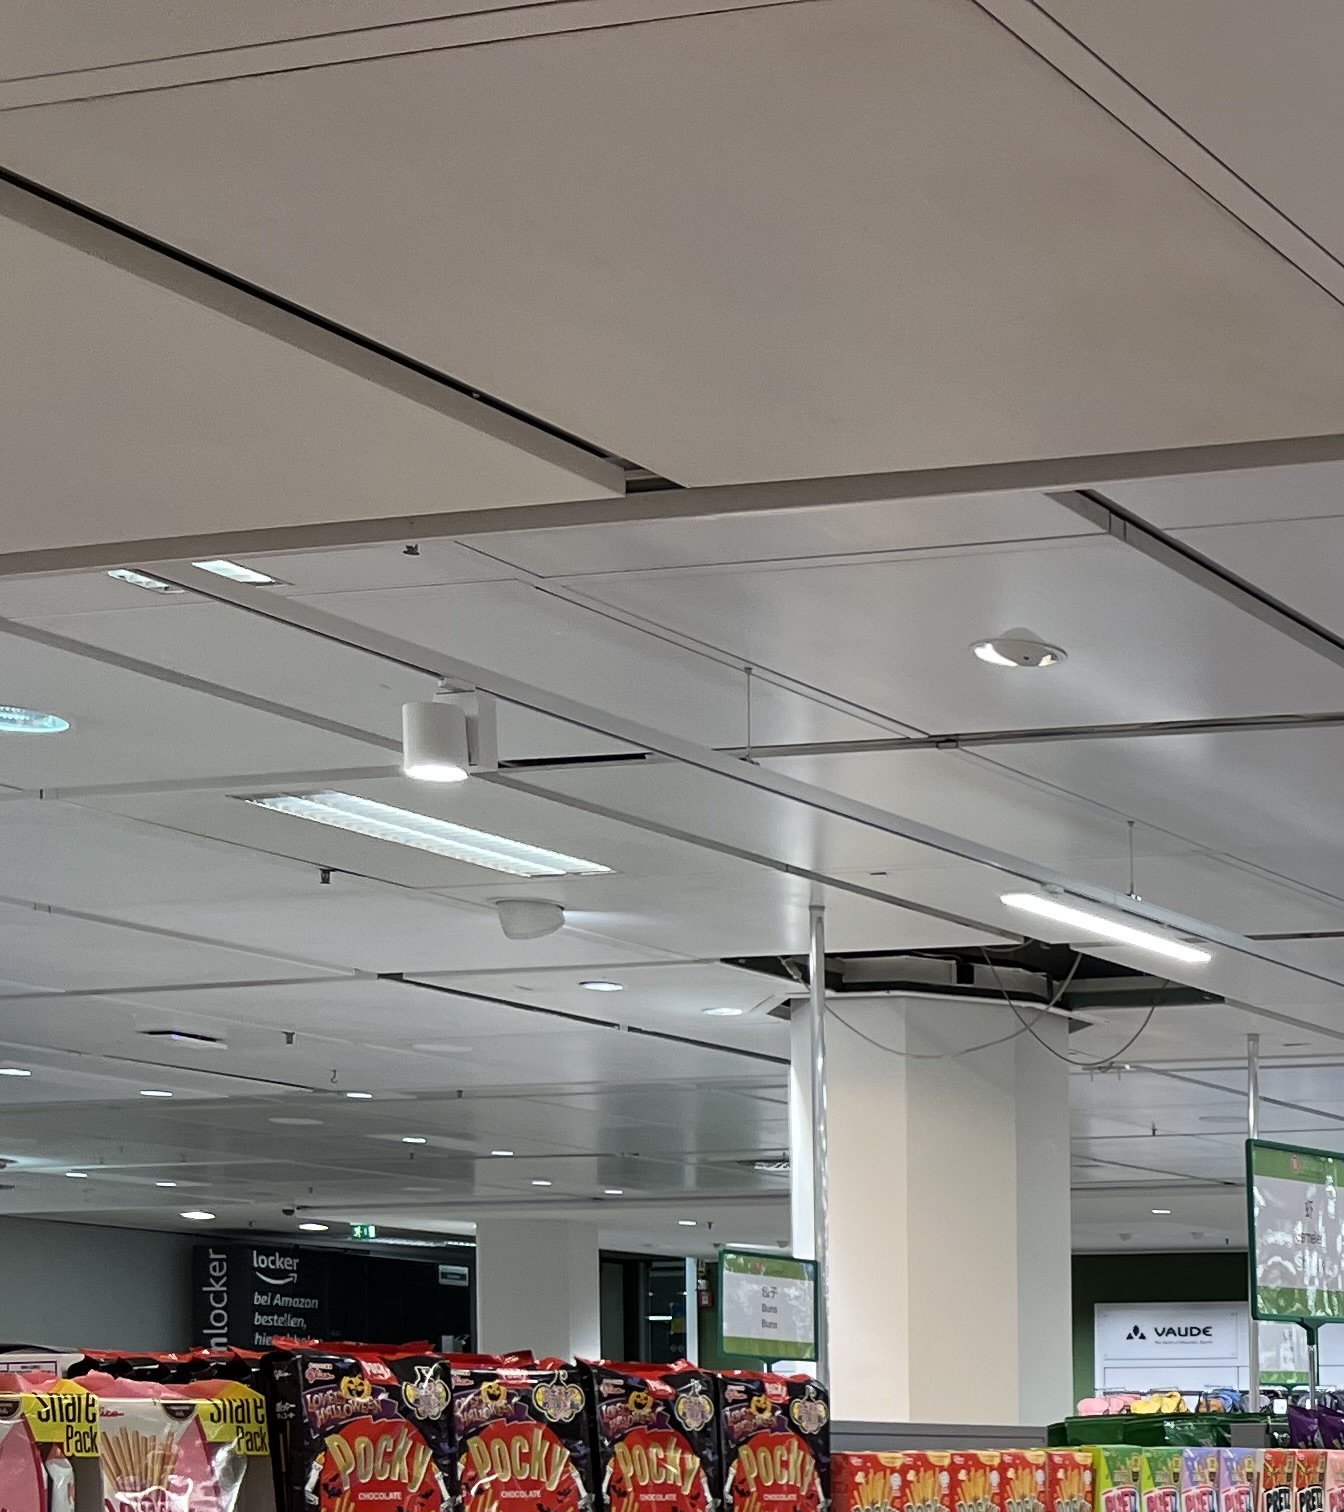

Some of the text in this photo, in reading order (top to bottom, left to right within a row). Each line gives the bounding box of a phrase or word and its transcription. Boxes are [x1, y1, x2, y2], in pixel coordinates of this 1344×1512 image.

[252, 1250, 299, 1271] locker
[253, 1292, 319, 1309] bei Amazon
[254, 1312, 307, 1330] bestellen,
[1154, 1326, 1213, 1337] VAUDE
[66, 1424, 98, 1455] Pack
[236, 1425, 268, 1455] Pack
